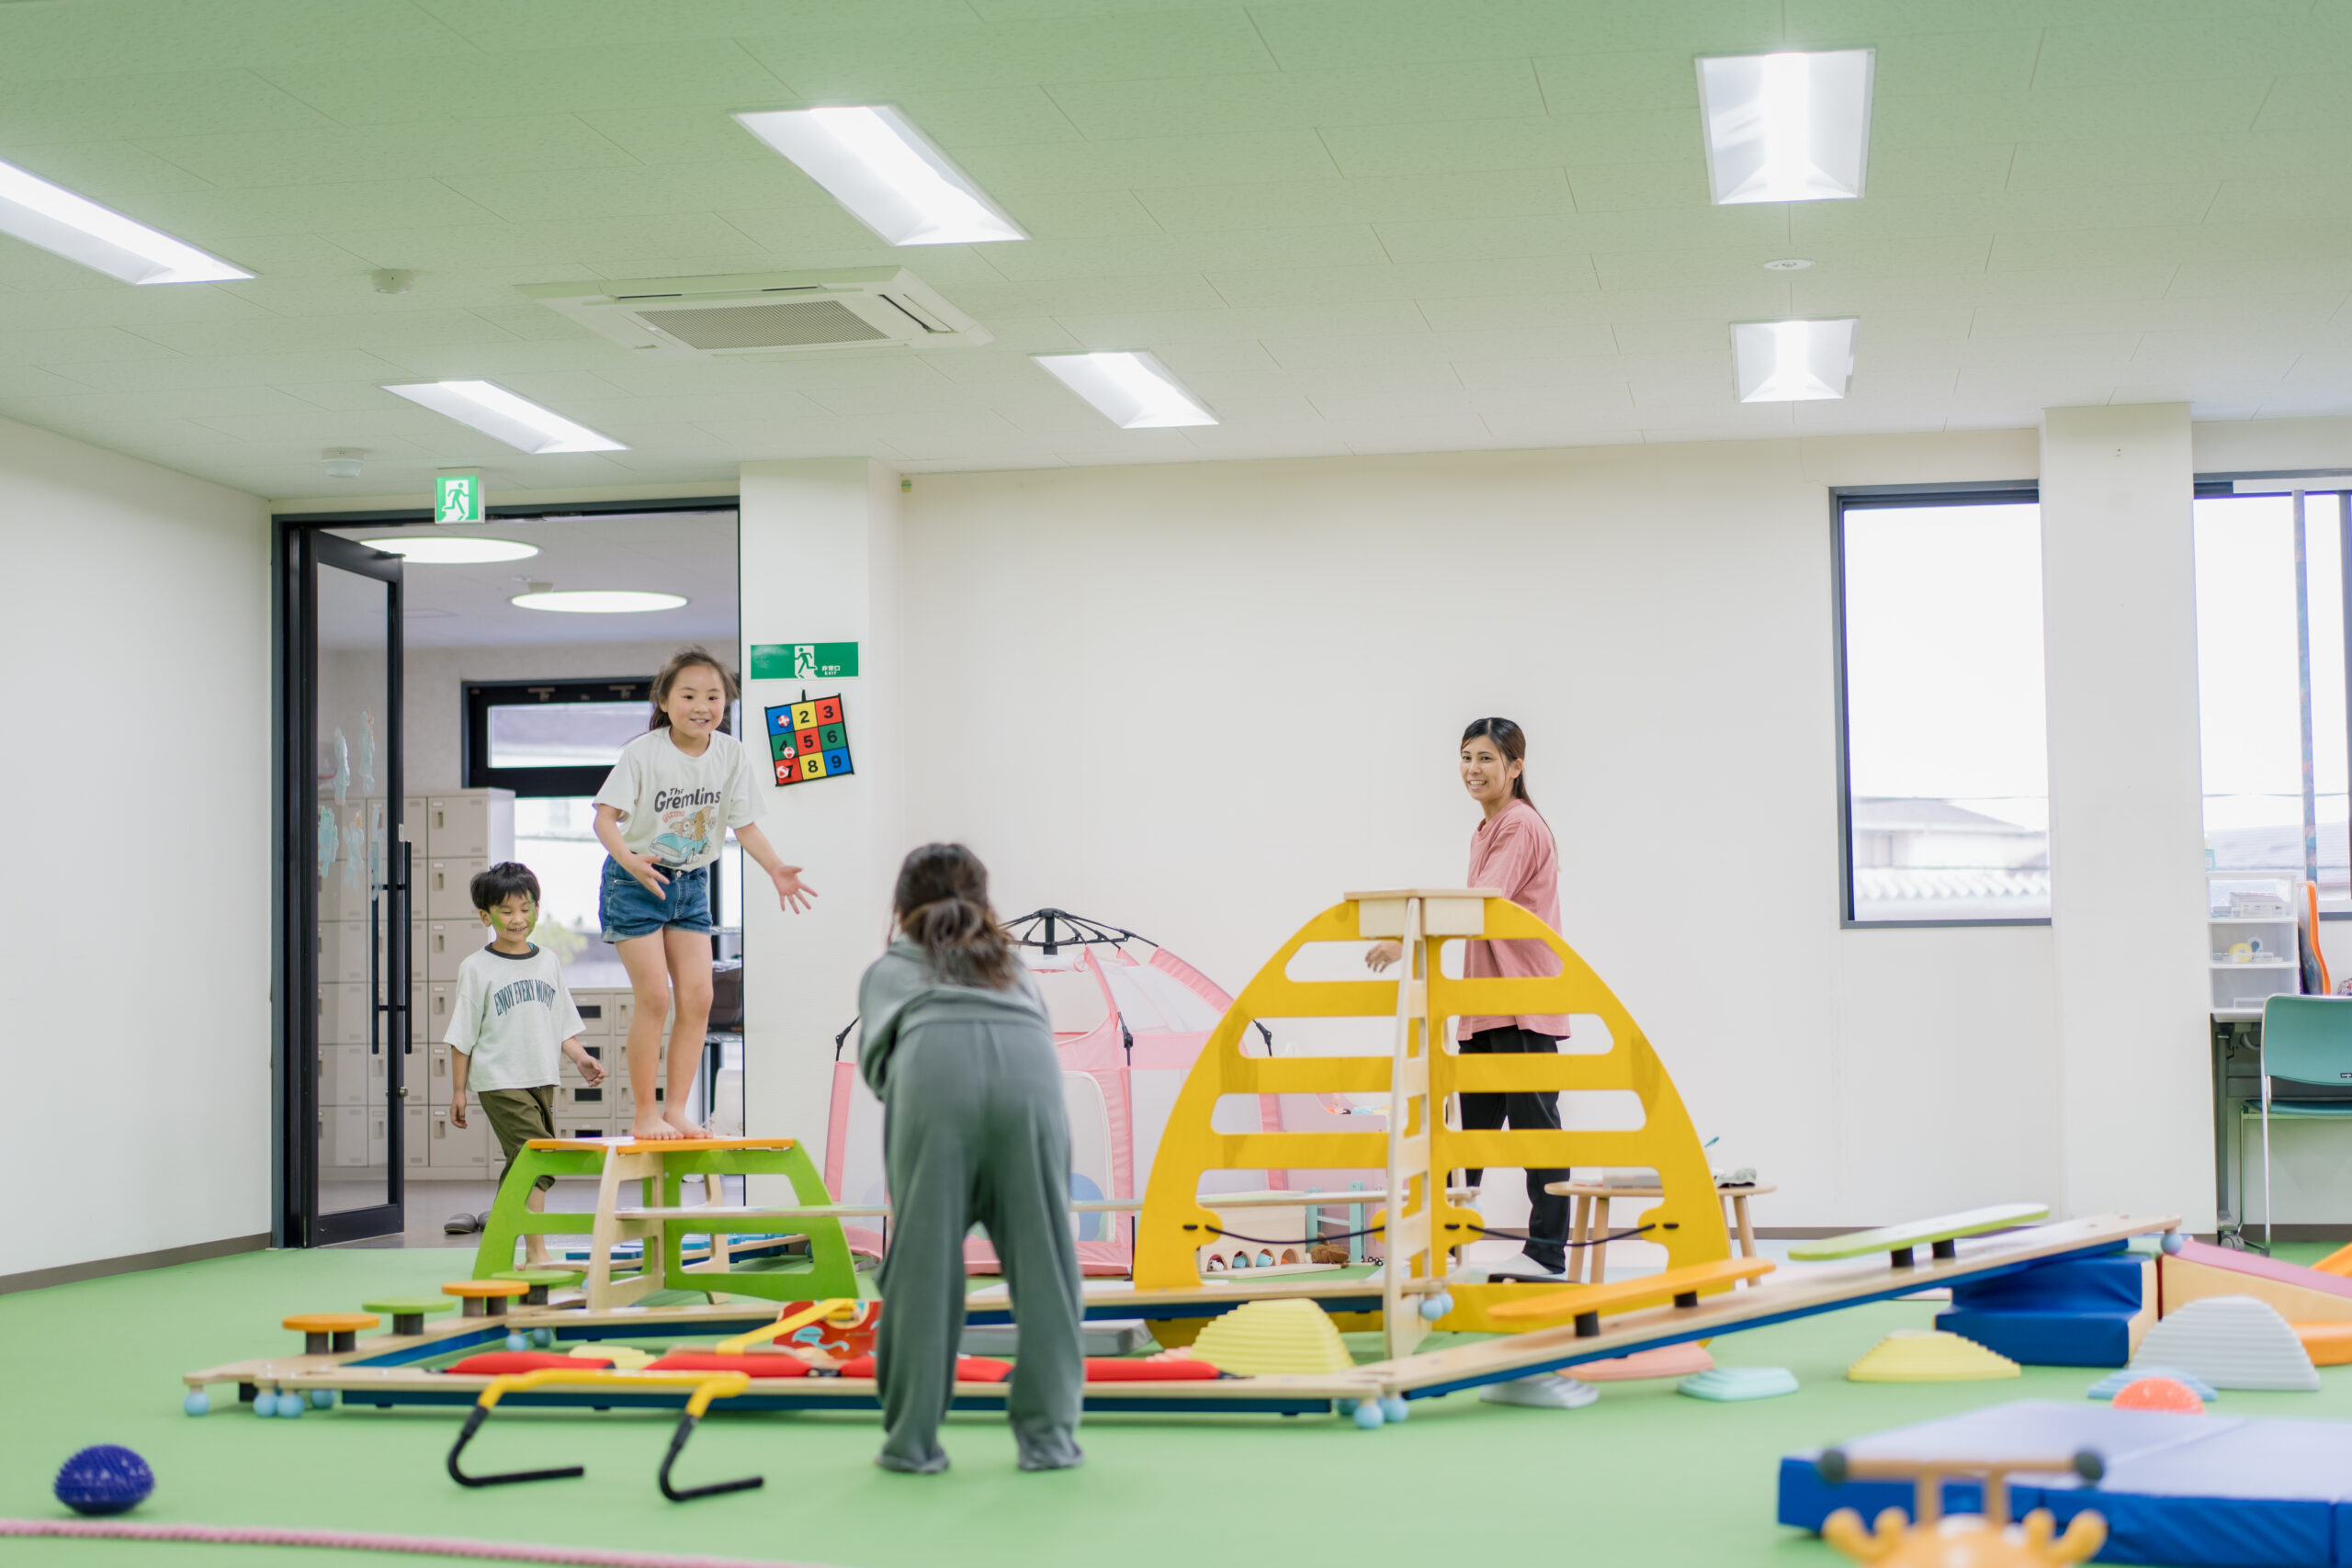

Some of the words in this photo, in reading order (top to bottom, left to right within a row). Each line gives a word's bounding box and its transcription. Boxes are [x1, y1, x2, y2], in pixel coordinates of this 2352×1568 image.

[799, 710, 810, 724] 2
[823, 705, 834, 718] 3
[803, 735, 814, 749] 5
[827, 730, 838, 743] 6
[808, 760, 819, 773] 8
[831, 755, 842, 769] 9
[654, 787, 721, 812] Gremlins
[670, 787, 684, 795] The
[494, 984, 514, 1016] ENJOY
[513, 979, 535, 1004] EVERY
